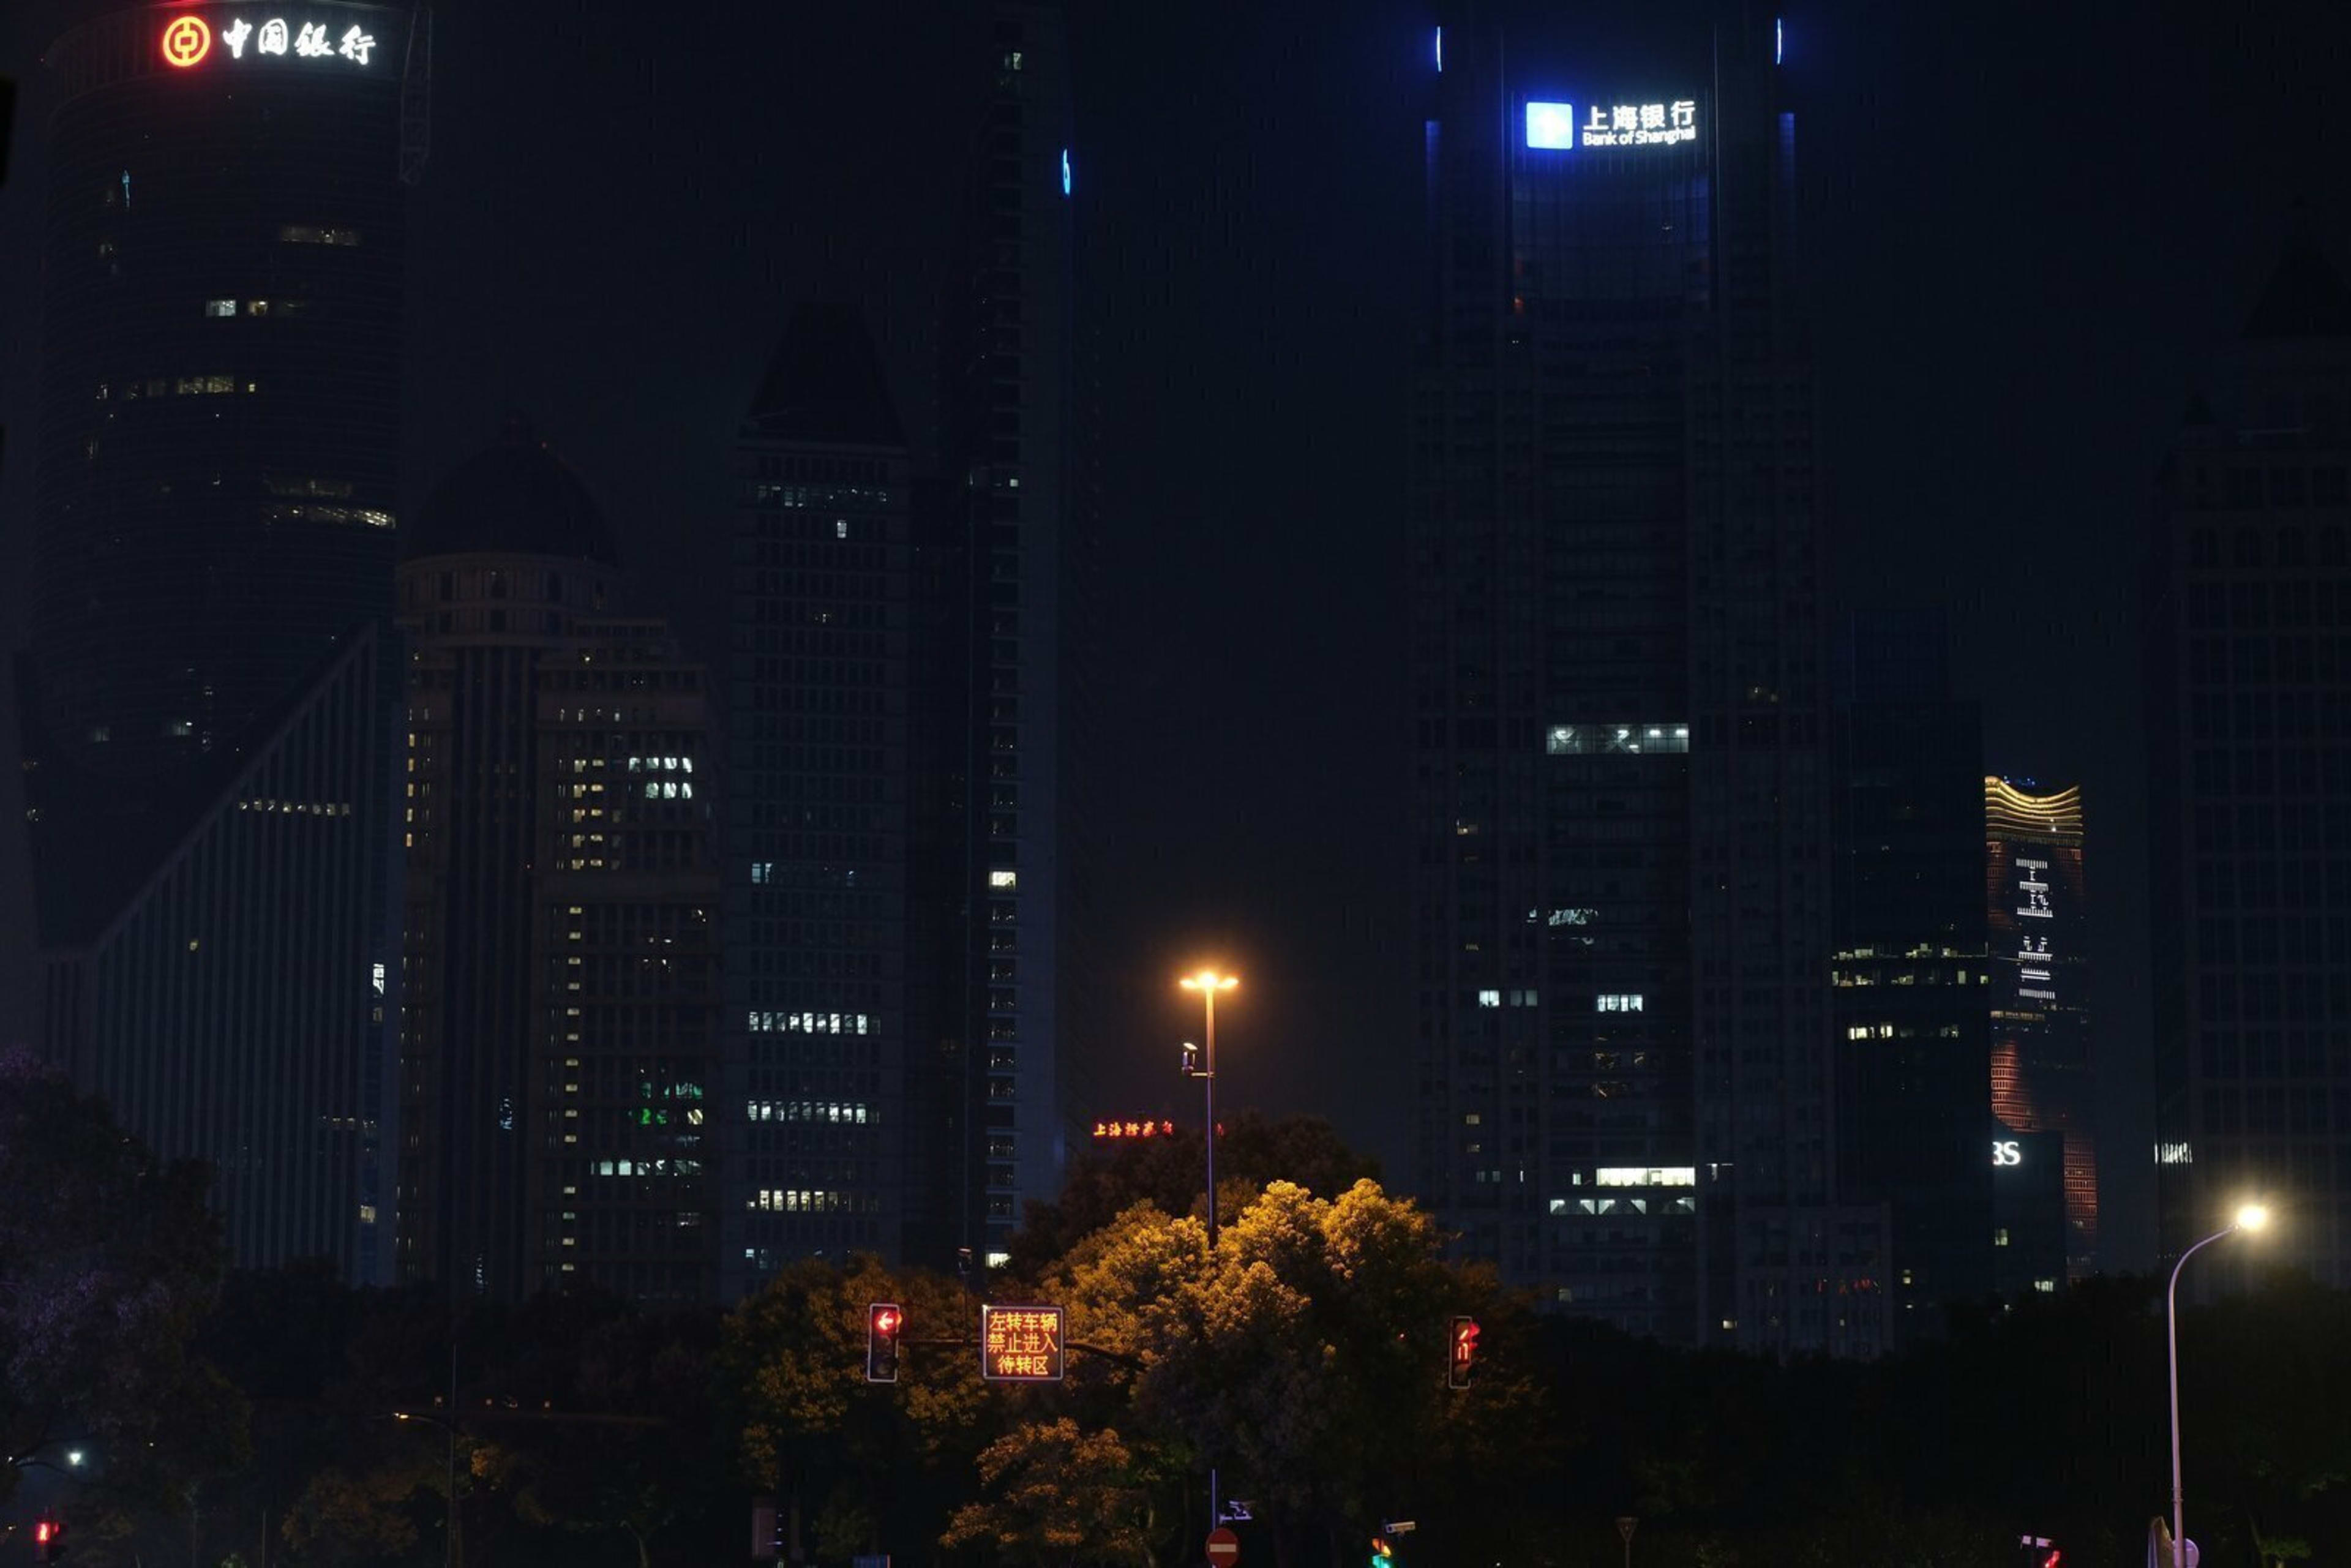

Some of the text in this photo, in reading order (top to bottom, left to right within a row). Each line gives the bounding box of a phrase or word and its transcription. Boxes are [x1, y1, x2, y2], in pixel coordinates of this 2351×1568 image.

[1583, 100, 1695, 130] 上海银行
[1583, 126, 1696, 146] Bank of Shanghai
[989, 1312, 1057, 1332] 左转车辆
[988, 1332, 1058, 1354] 禁止进入
[997, 1355, 1048, 1375] 待转区
